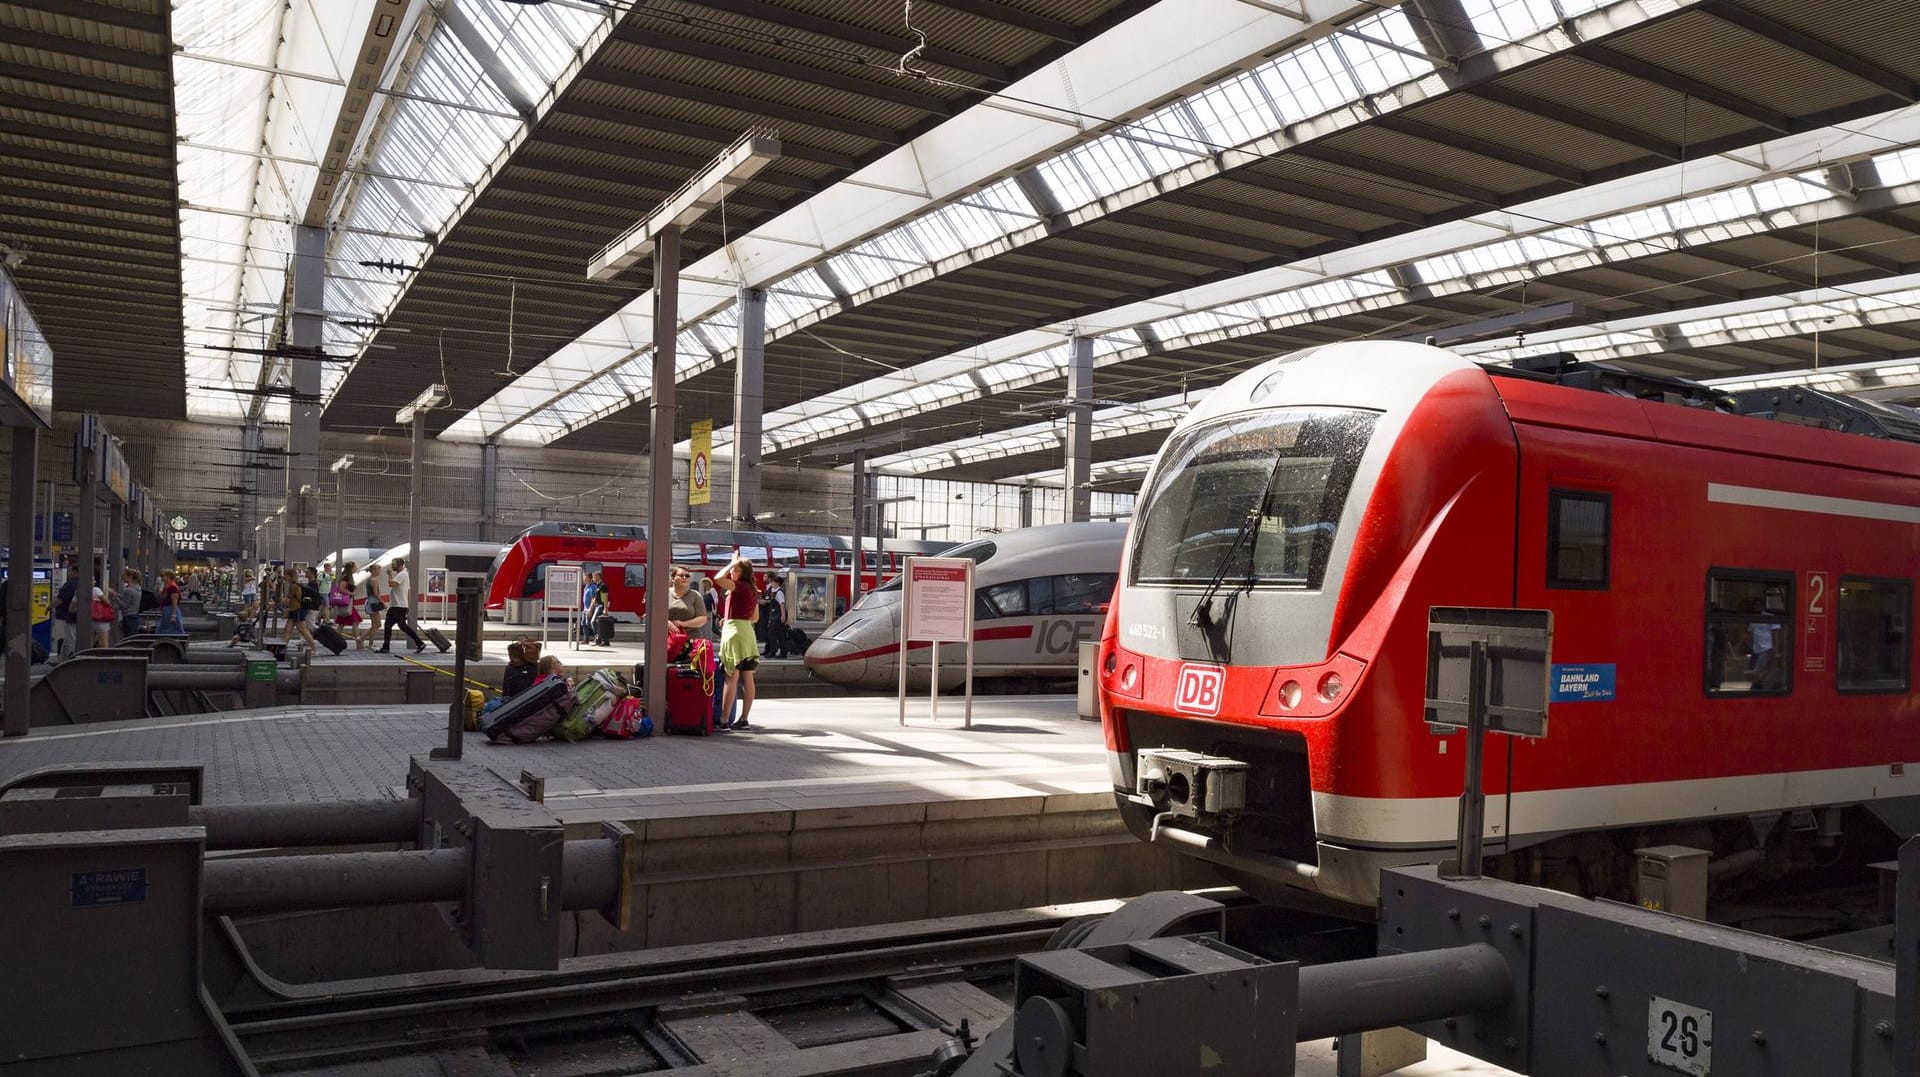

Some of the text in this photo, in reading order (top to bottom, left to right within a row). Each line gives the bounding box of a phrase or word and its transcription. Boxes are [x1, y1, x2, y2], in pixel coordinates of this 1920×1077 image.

[1808, 575, 1824, 614] 2
[1034, 619, 1096, 655] ICE
[1180, 671, 1218, 707] DB
[1559, 683, 1589, 693] BAYERN
[1560, 673, 1600, 683] BAHNLAND
[1660, 1010, 1699, 1058] 26
